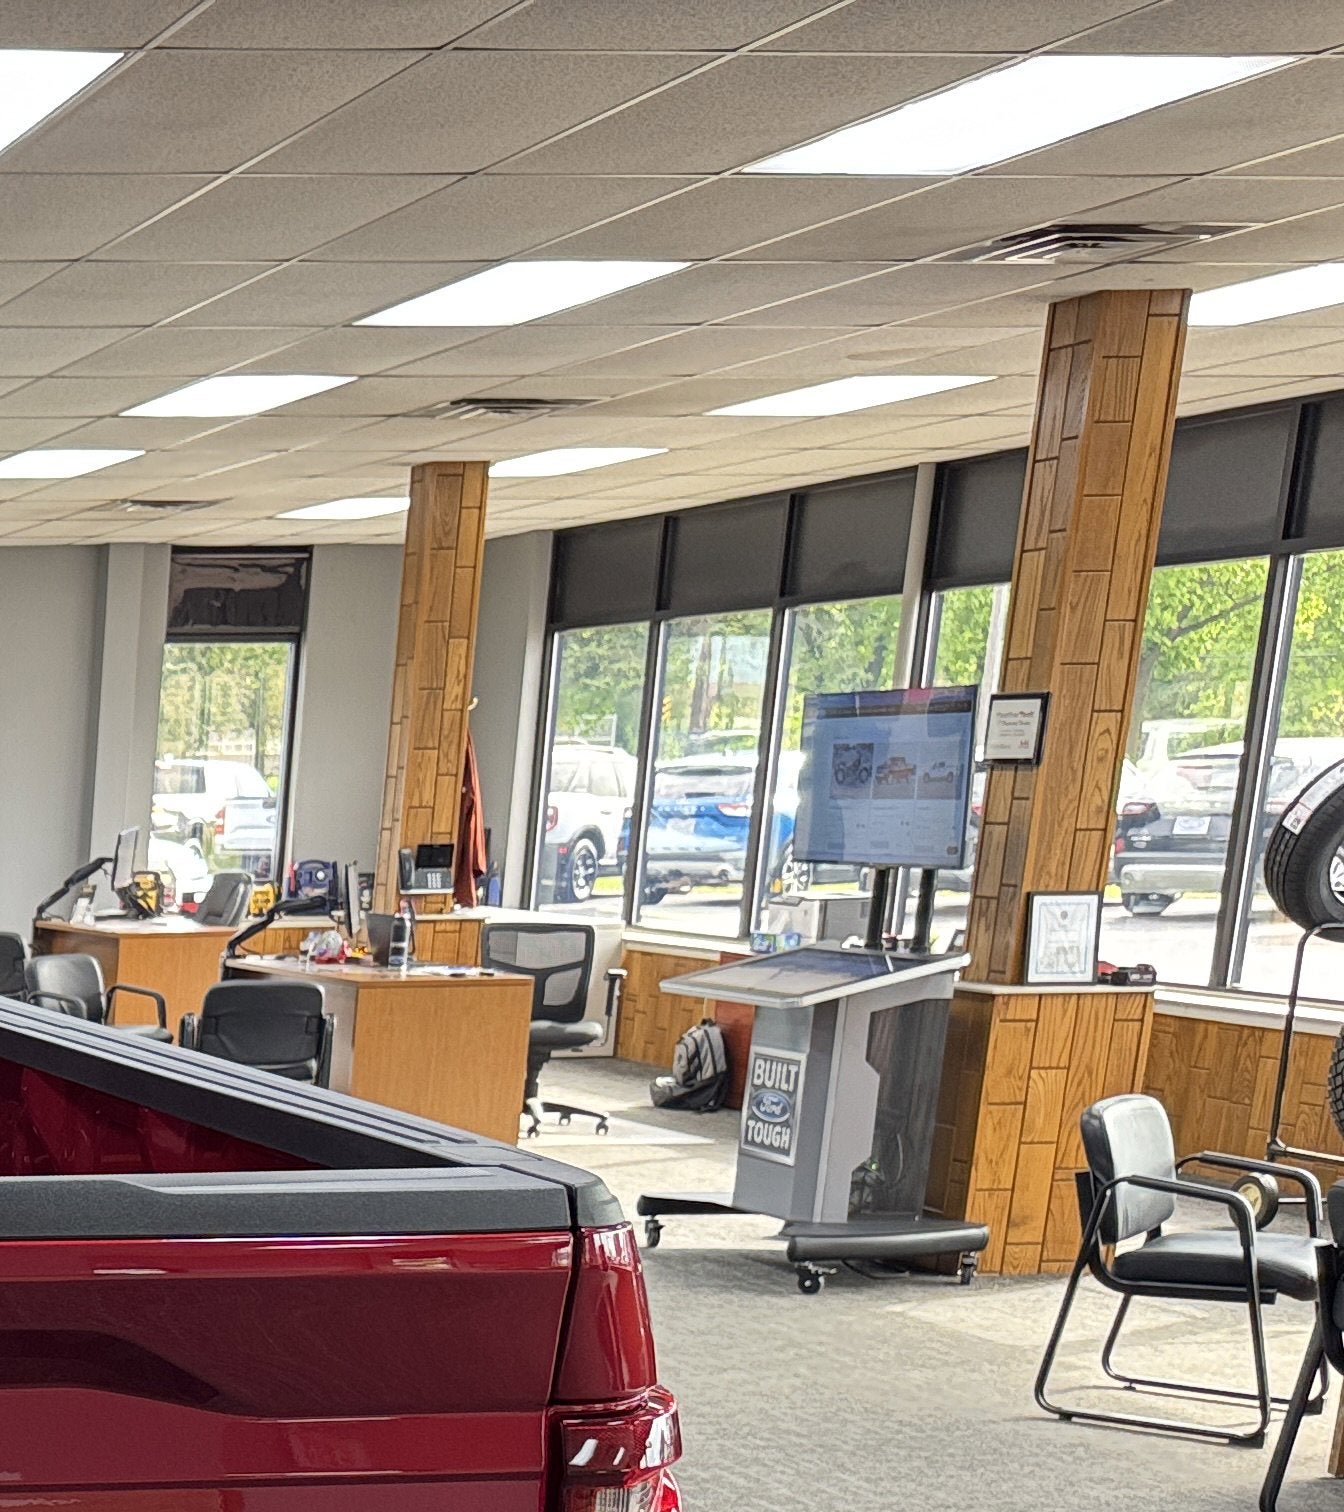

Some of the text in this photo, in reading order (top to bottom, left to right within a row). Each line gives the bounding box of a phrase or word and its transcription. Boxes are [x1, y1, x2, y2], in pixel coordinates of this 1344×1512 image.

[753, 1058, 799, 1092] BUILT
[759, 1095, 783, 1115] Ford
[747, 1120, 791, 1149] TOUGH
